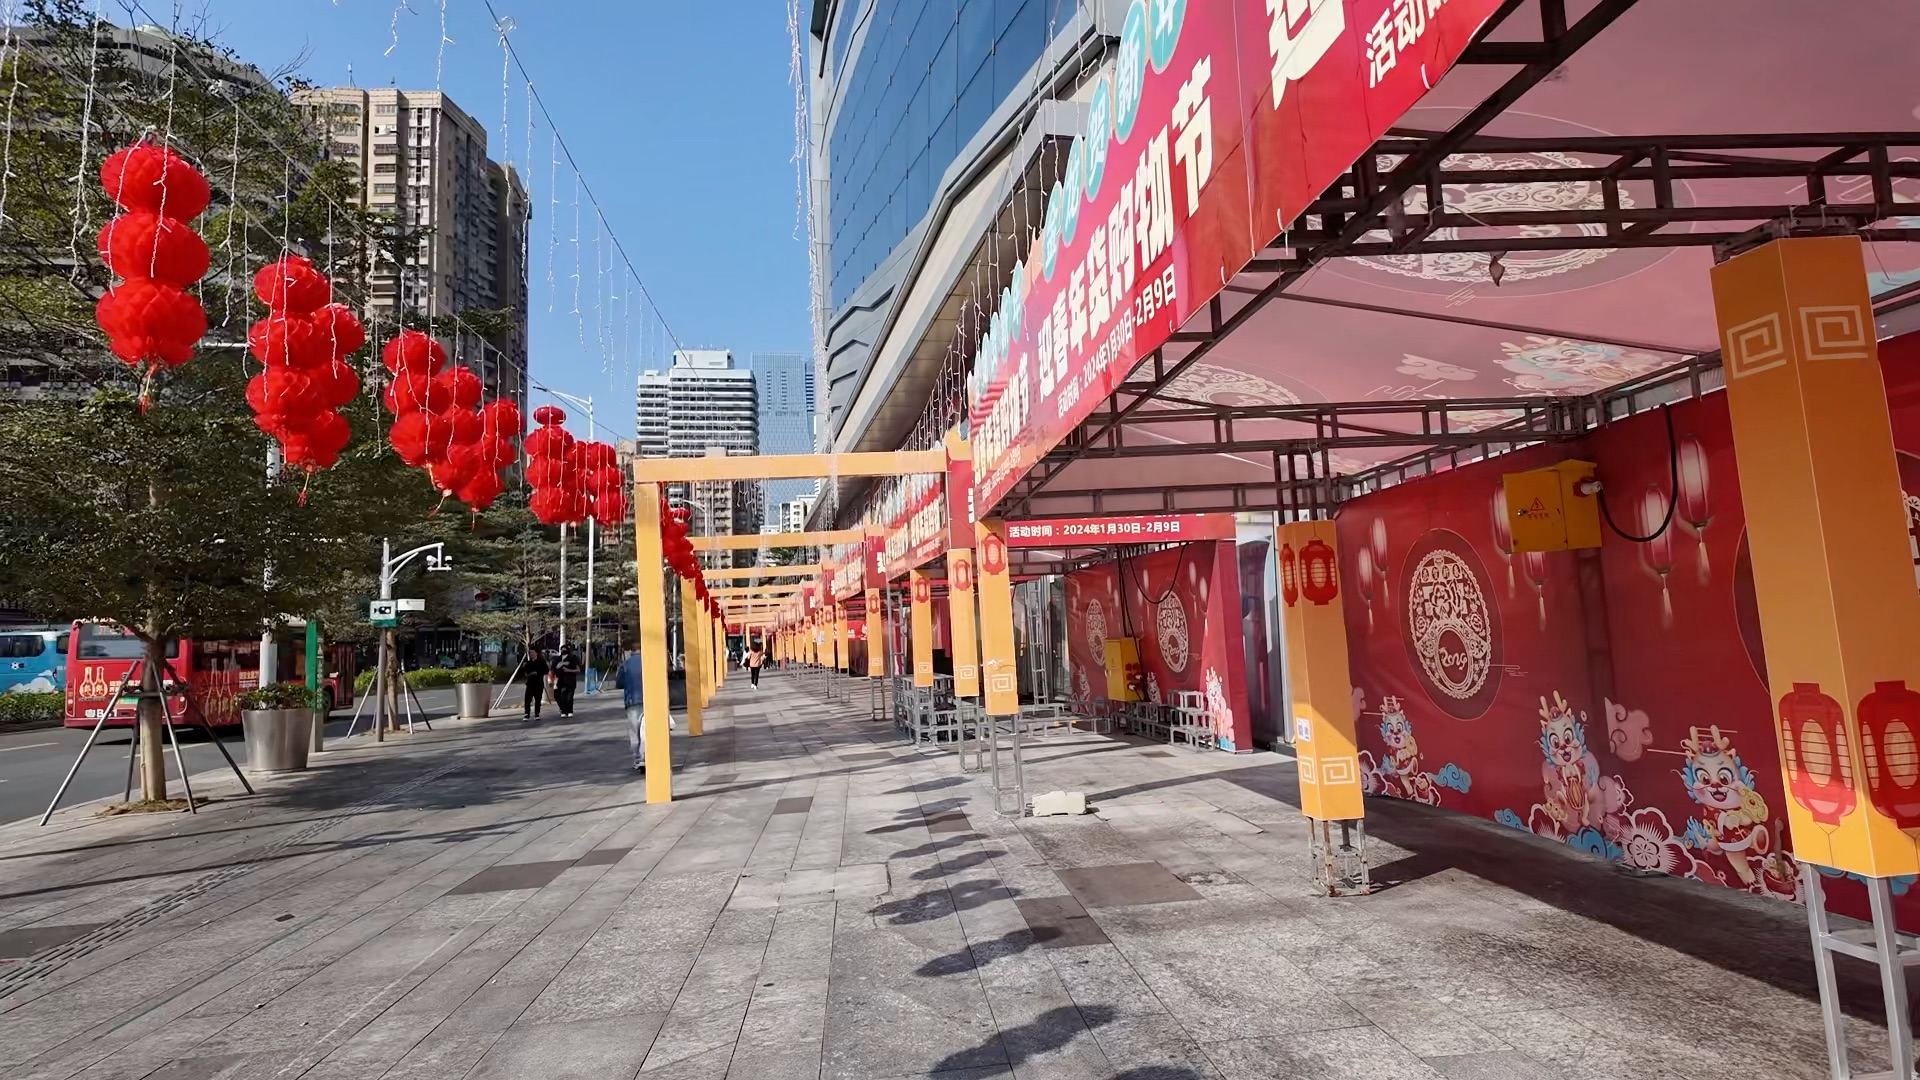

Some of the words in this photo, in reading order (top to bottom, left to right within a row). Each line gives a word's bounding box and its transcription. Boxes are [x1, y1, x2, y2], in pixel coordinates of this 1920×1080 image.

[1038, 54, 1213, 403] 迎春年货购物节
[1009, 521, 1180, 537] 活动时间：2024年1月30日-2月9日
